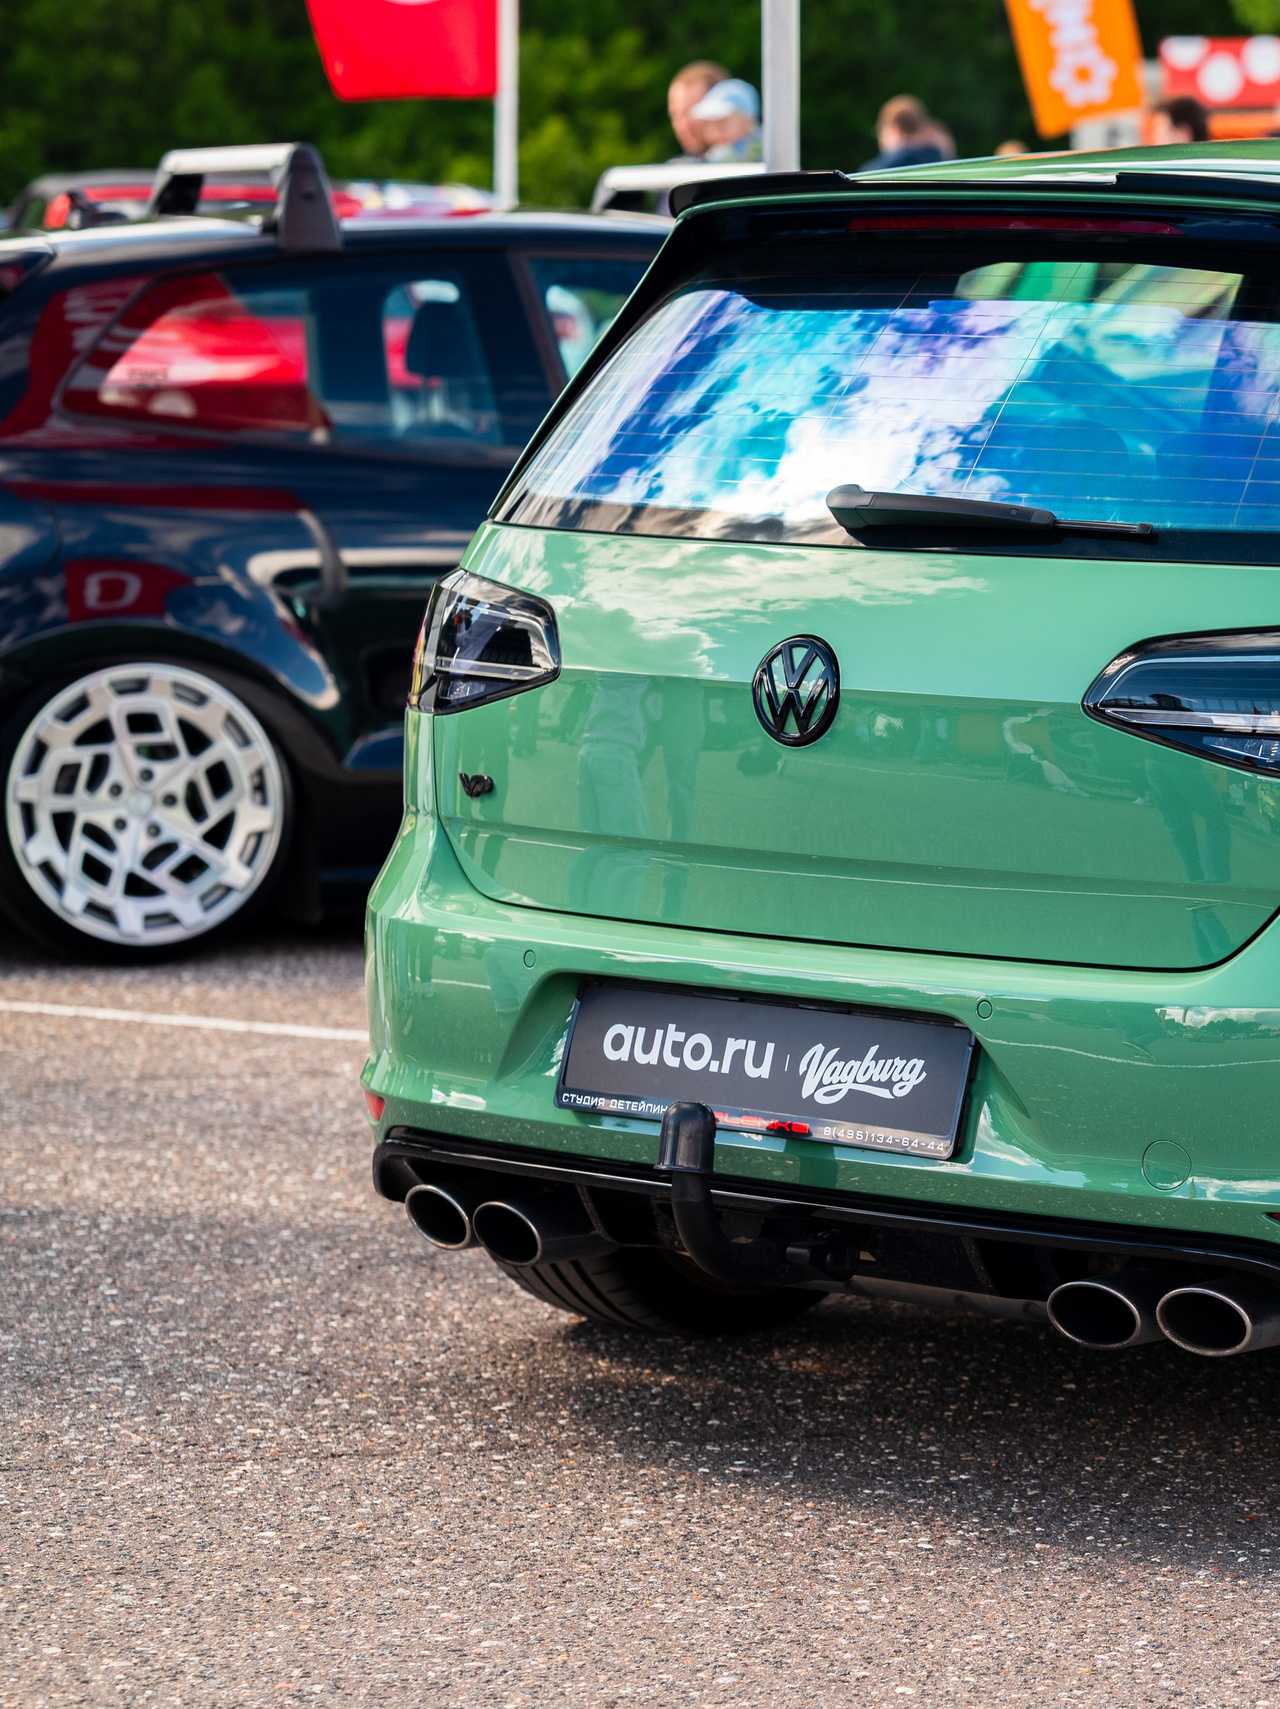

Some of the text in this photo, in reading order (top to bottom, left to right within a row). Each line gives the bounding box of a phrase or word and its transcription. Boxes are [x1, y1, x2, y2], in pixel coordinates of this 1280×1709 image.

[603, 1022, 775, 1079] auto.ru
[799, 1043, 927, 1105] Vagburg
[562, 1092, 668, 1115] СТУДИЯ ДЕТЕЙЛИН
[823, 1126, 945, 1151] 8(495)134-64-44
